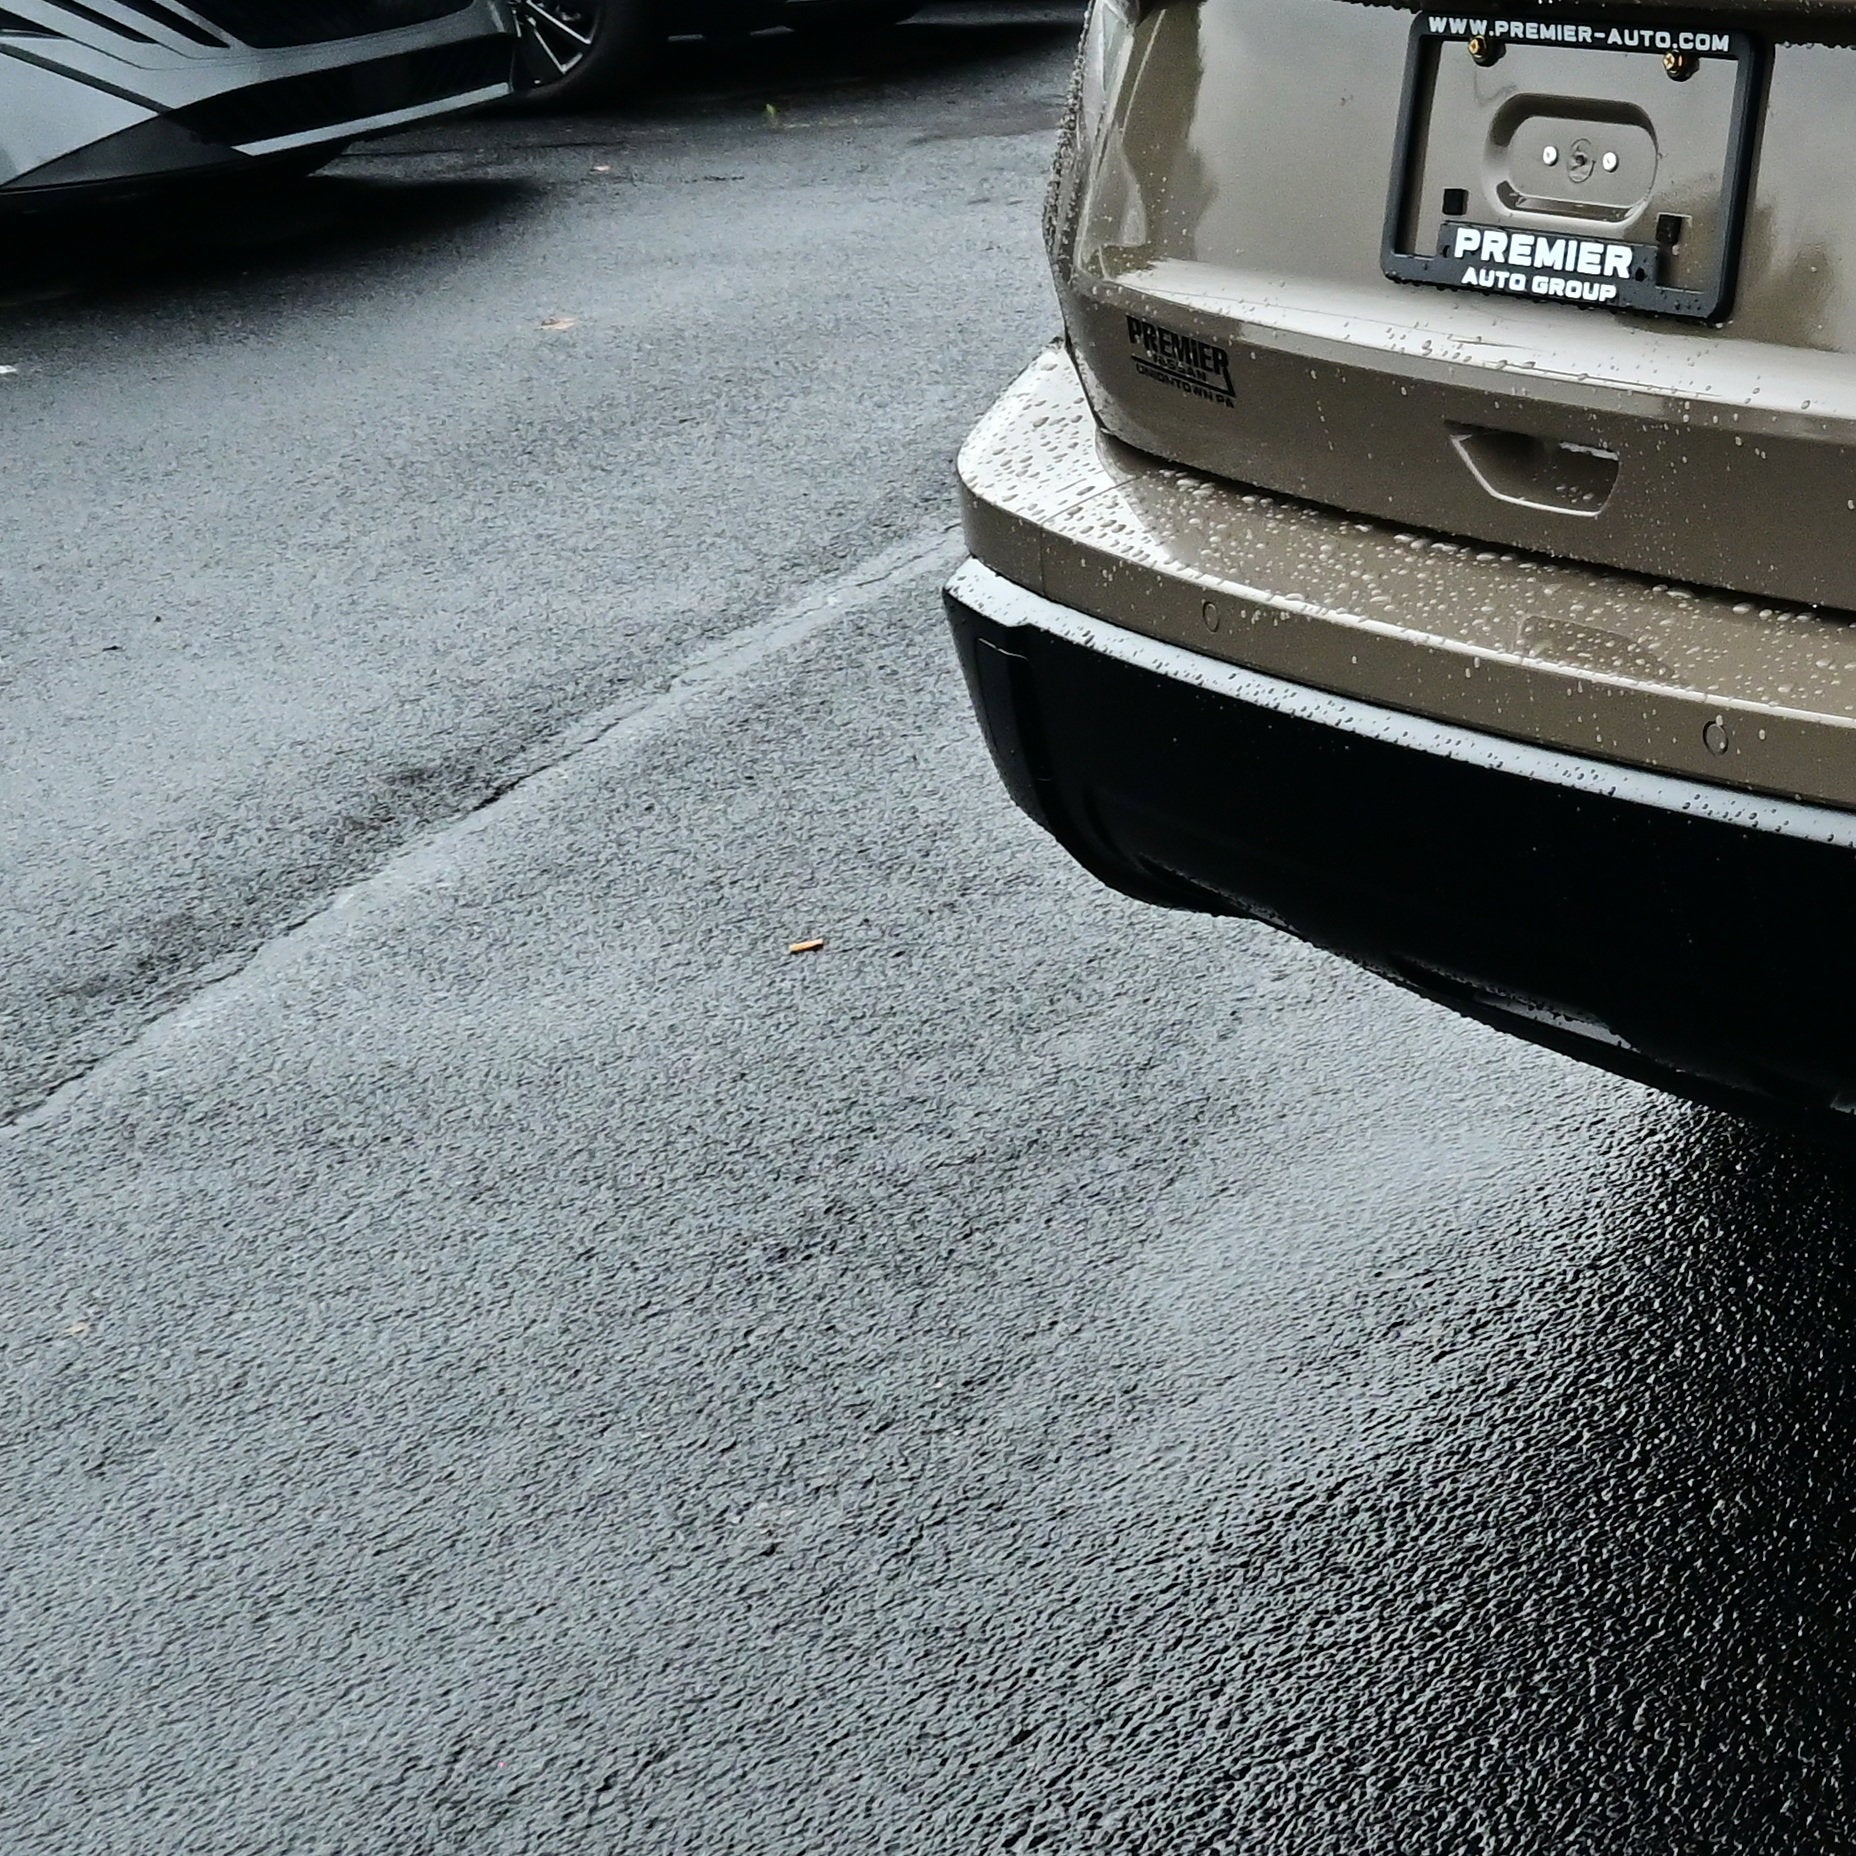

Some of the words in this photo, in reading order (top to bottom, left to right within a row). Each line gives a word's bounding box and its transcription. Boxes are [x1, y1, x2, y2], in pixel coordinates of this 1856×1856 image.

[1428, 16, 1729, 52] WWW.PREMIER-AUTO.COM
[1454, 227, 1634, 279] PREMIER
[1461, 266, 1527, 292] AUTO
[1531, 274, 1618, 302] GROUP
[1125, 314, 1231, 380] PREMIER
